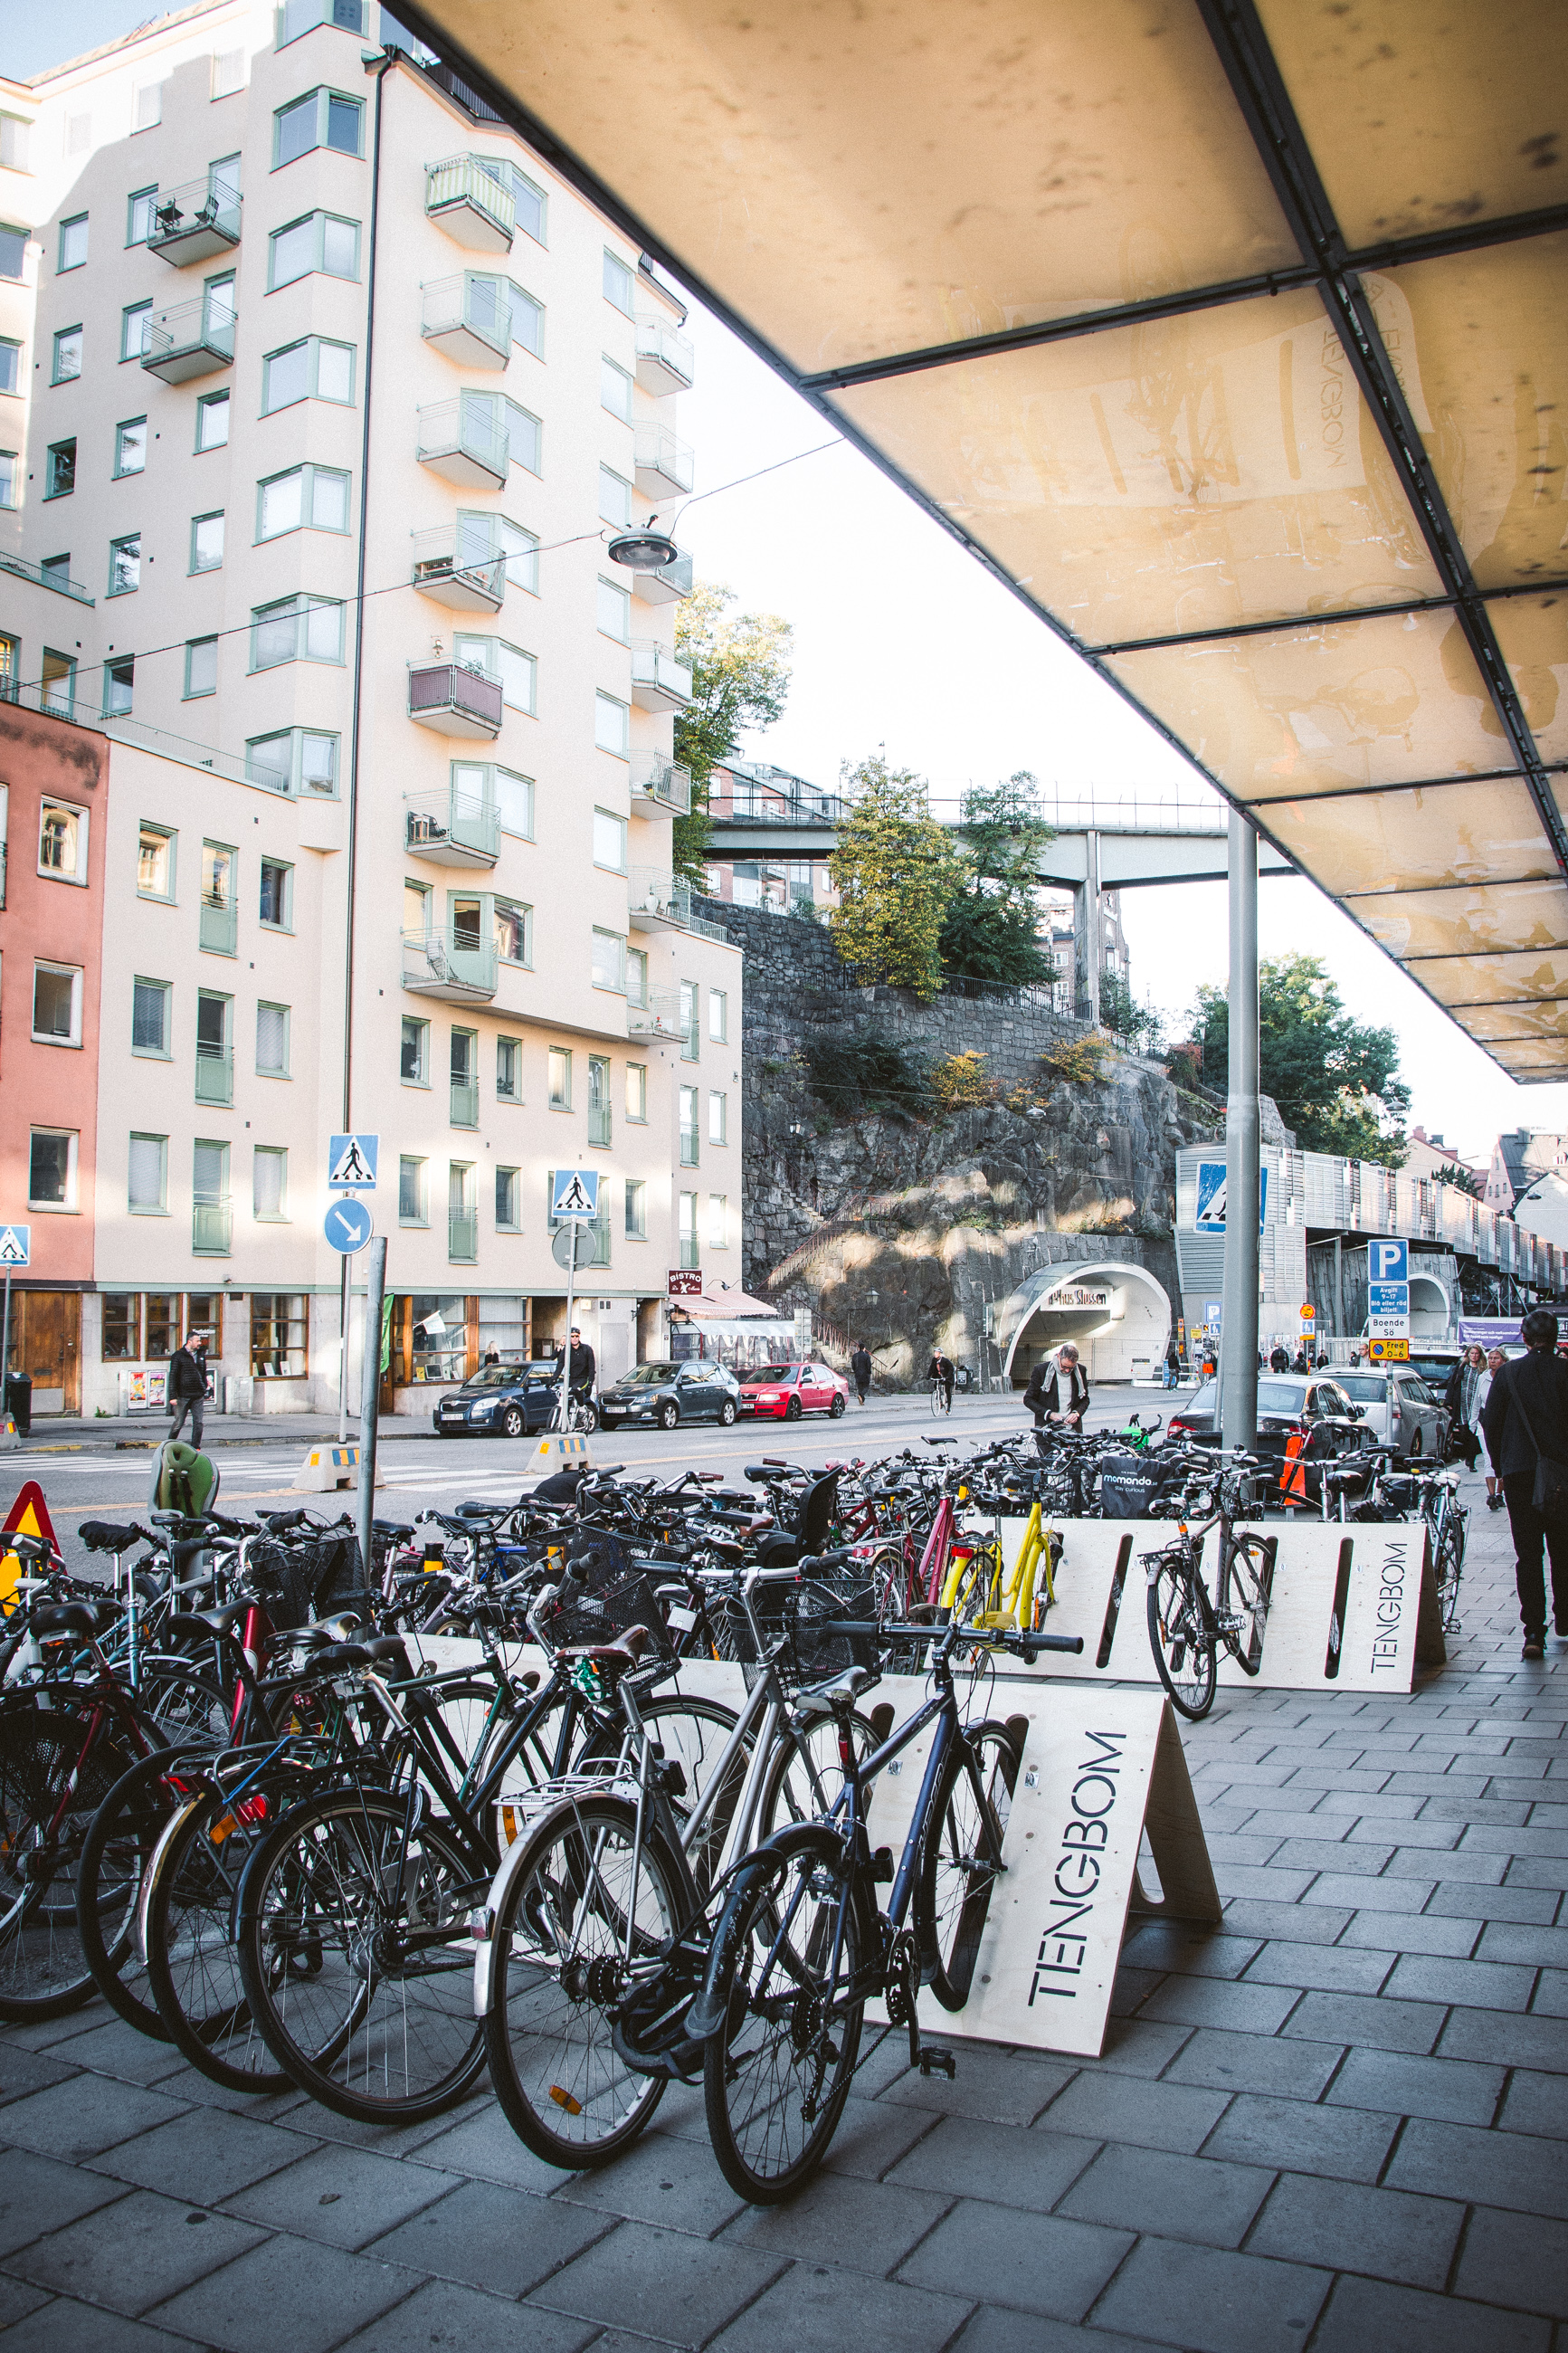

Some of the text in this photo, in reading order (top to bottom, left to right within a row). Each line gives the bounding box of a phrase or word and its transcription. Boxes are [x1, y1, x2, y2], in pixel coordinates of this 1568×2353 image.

[1379, 1244, 1402, 1278] P
[1074, 1290, 1106, 1305] Slussen
[1373, 1319, 1404, 1327] Boende
[1383, 1329, 1394, 1337] Sö
[1371, 1542, 1408, 1673] TENGBOM
[1028, 1730, 1127, 2006] TENGBOM
